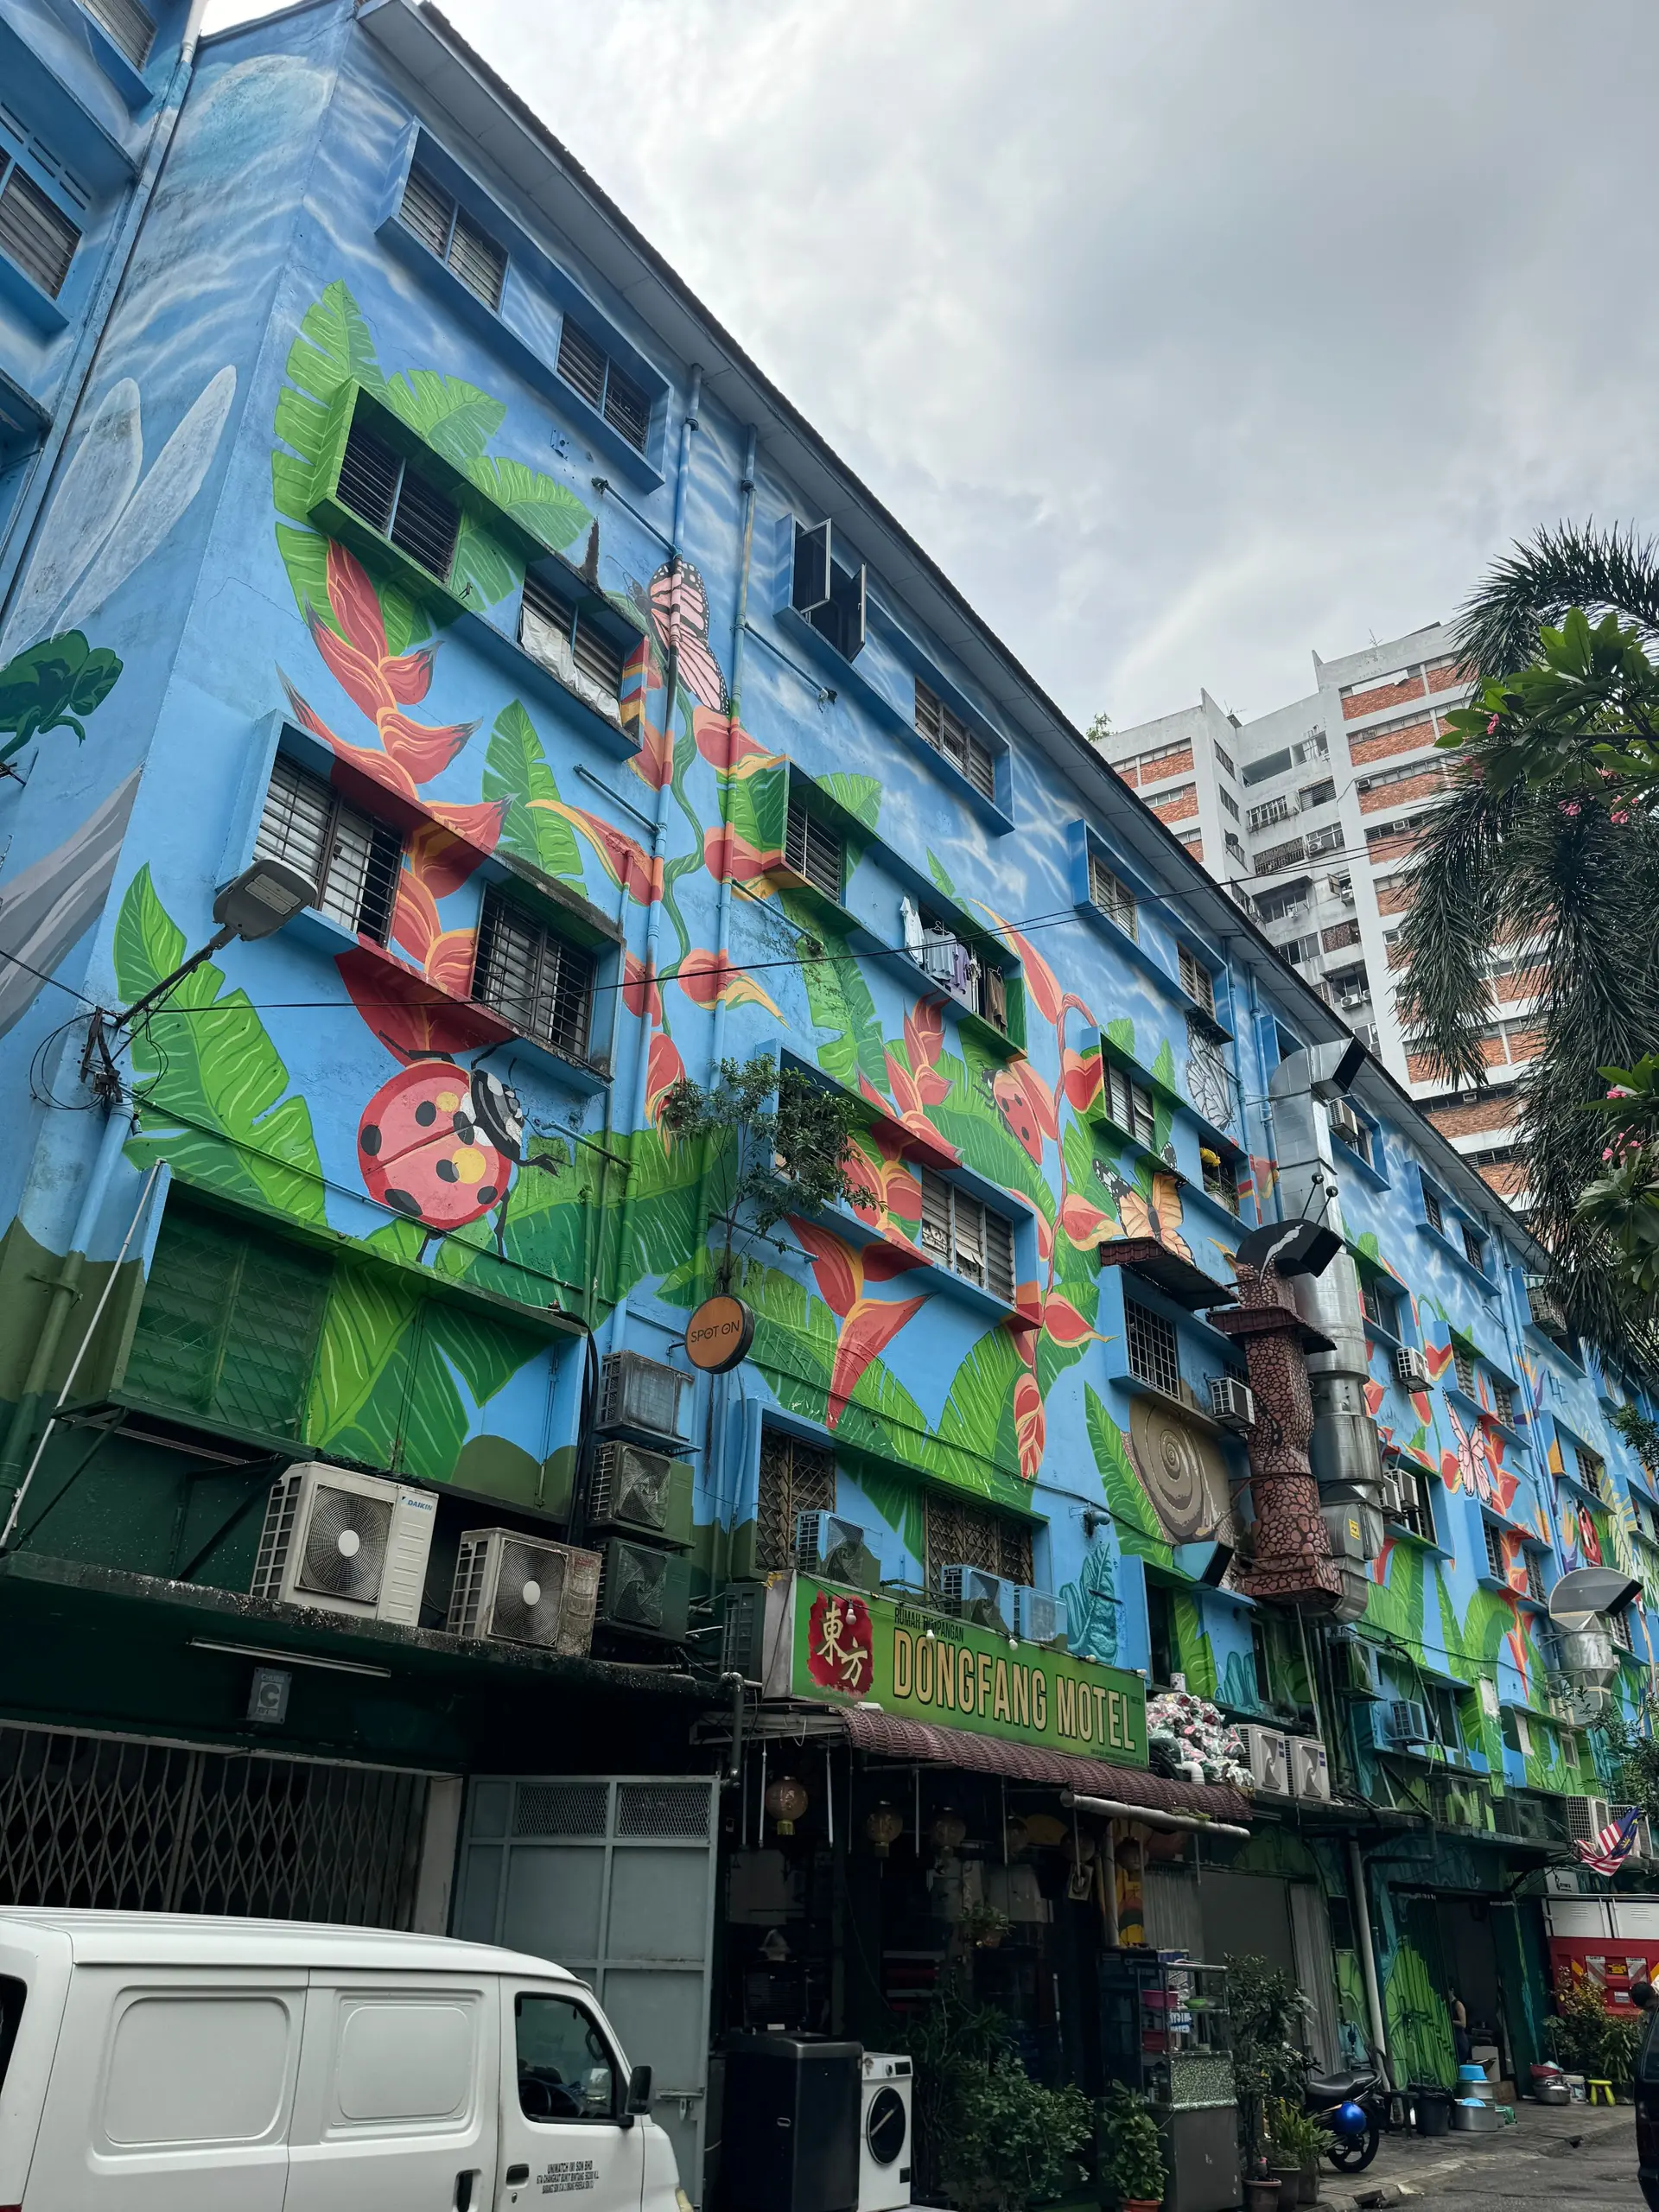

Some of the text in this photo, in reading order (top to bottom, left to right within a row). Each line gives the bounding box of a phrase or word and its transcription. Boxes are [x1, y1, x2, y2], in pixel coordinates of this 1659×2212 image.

[690, 1319, 740, 1343] SPOT ON
[407, 1499, 433, 1511] DAIKIN
[894, 1606, 964, 1643] RUMAH TMPANGAN
[817, 1600, 868, 1688] 東方
[893, 1626, 1136, 1752] DONGFANG MOTEL
